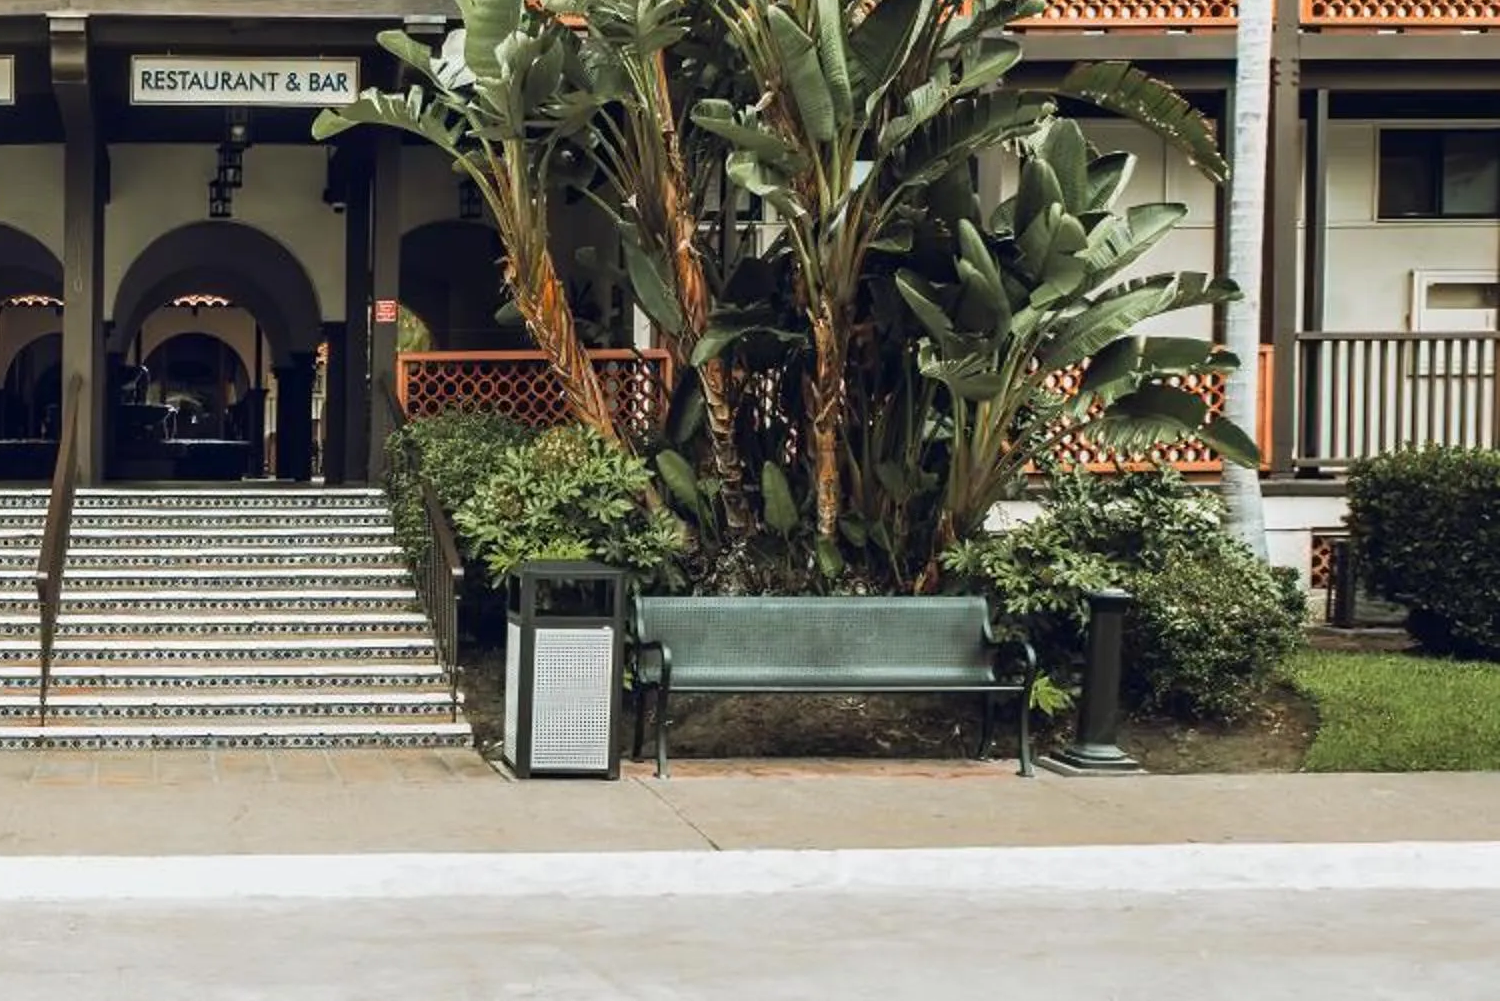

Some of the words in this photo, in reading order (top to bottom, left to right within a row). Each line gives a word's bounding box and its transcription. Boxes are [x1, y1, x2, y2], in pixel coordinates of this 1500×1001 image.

[141, 70, 279, 91] RESTAURANT
[285, 72, 301, 91] &
[309, 72, 348, 92] BAR
